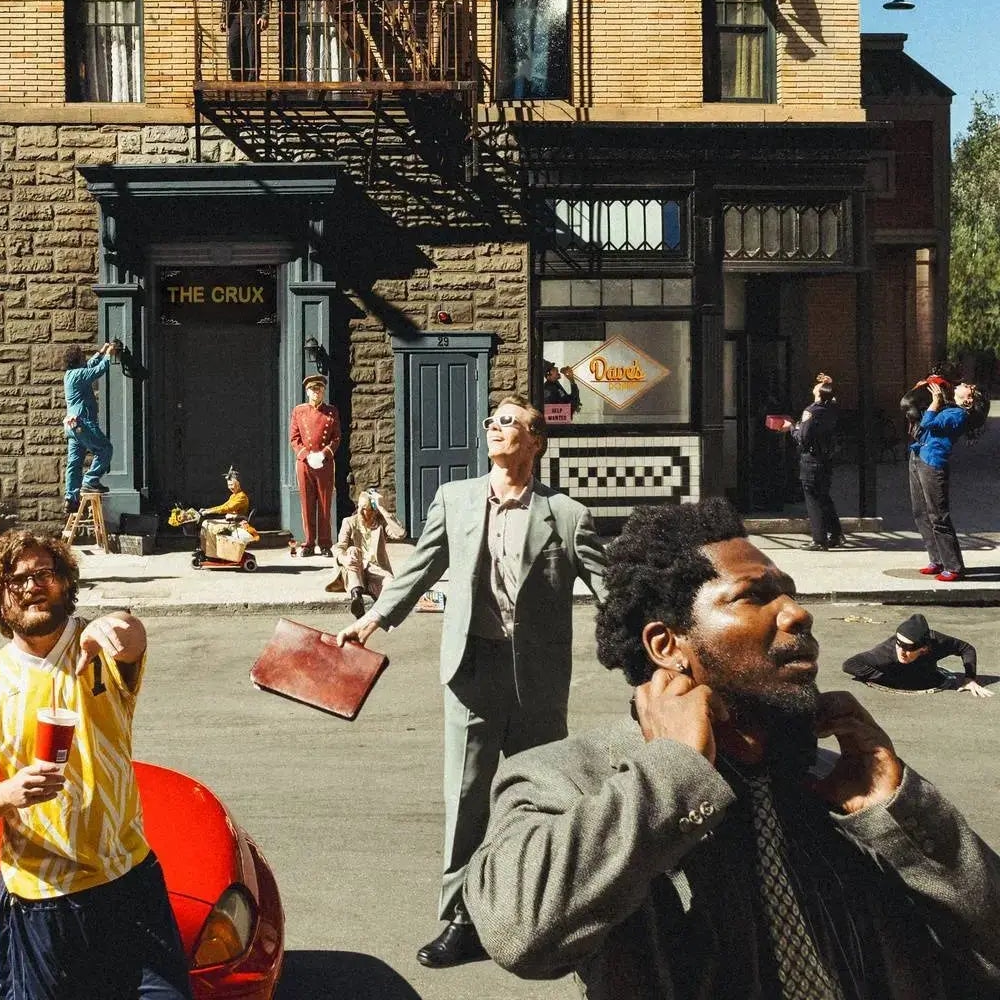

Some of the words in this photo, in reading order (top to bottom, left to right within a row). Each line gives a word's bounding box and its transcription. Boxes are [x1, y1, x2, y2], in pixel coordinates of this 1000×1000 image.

[167, 286, 205, 303] THE
[211, 286, 264, 303] CRUX
[437, 336, 449, 346] 29
[590, 357, 646, 381] Dave's
